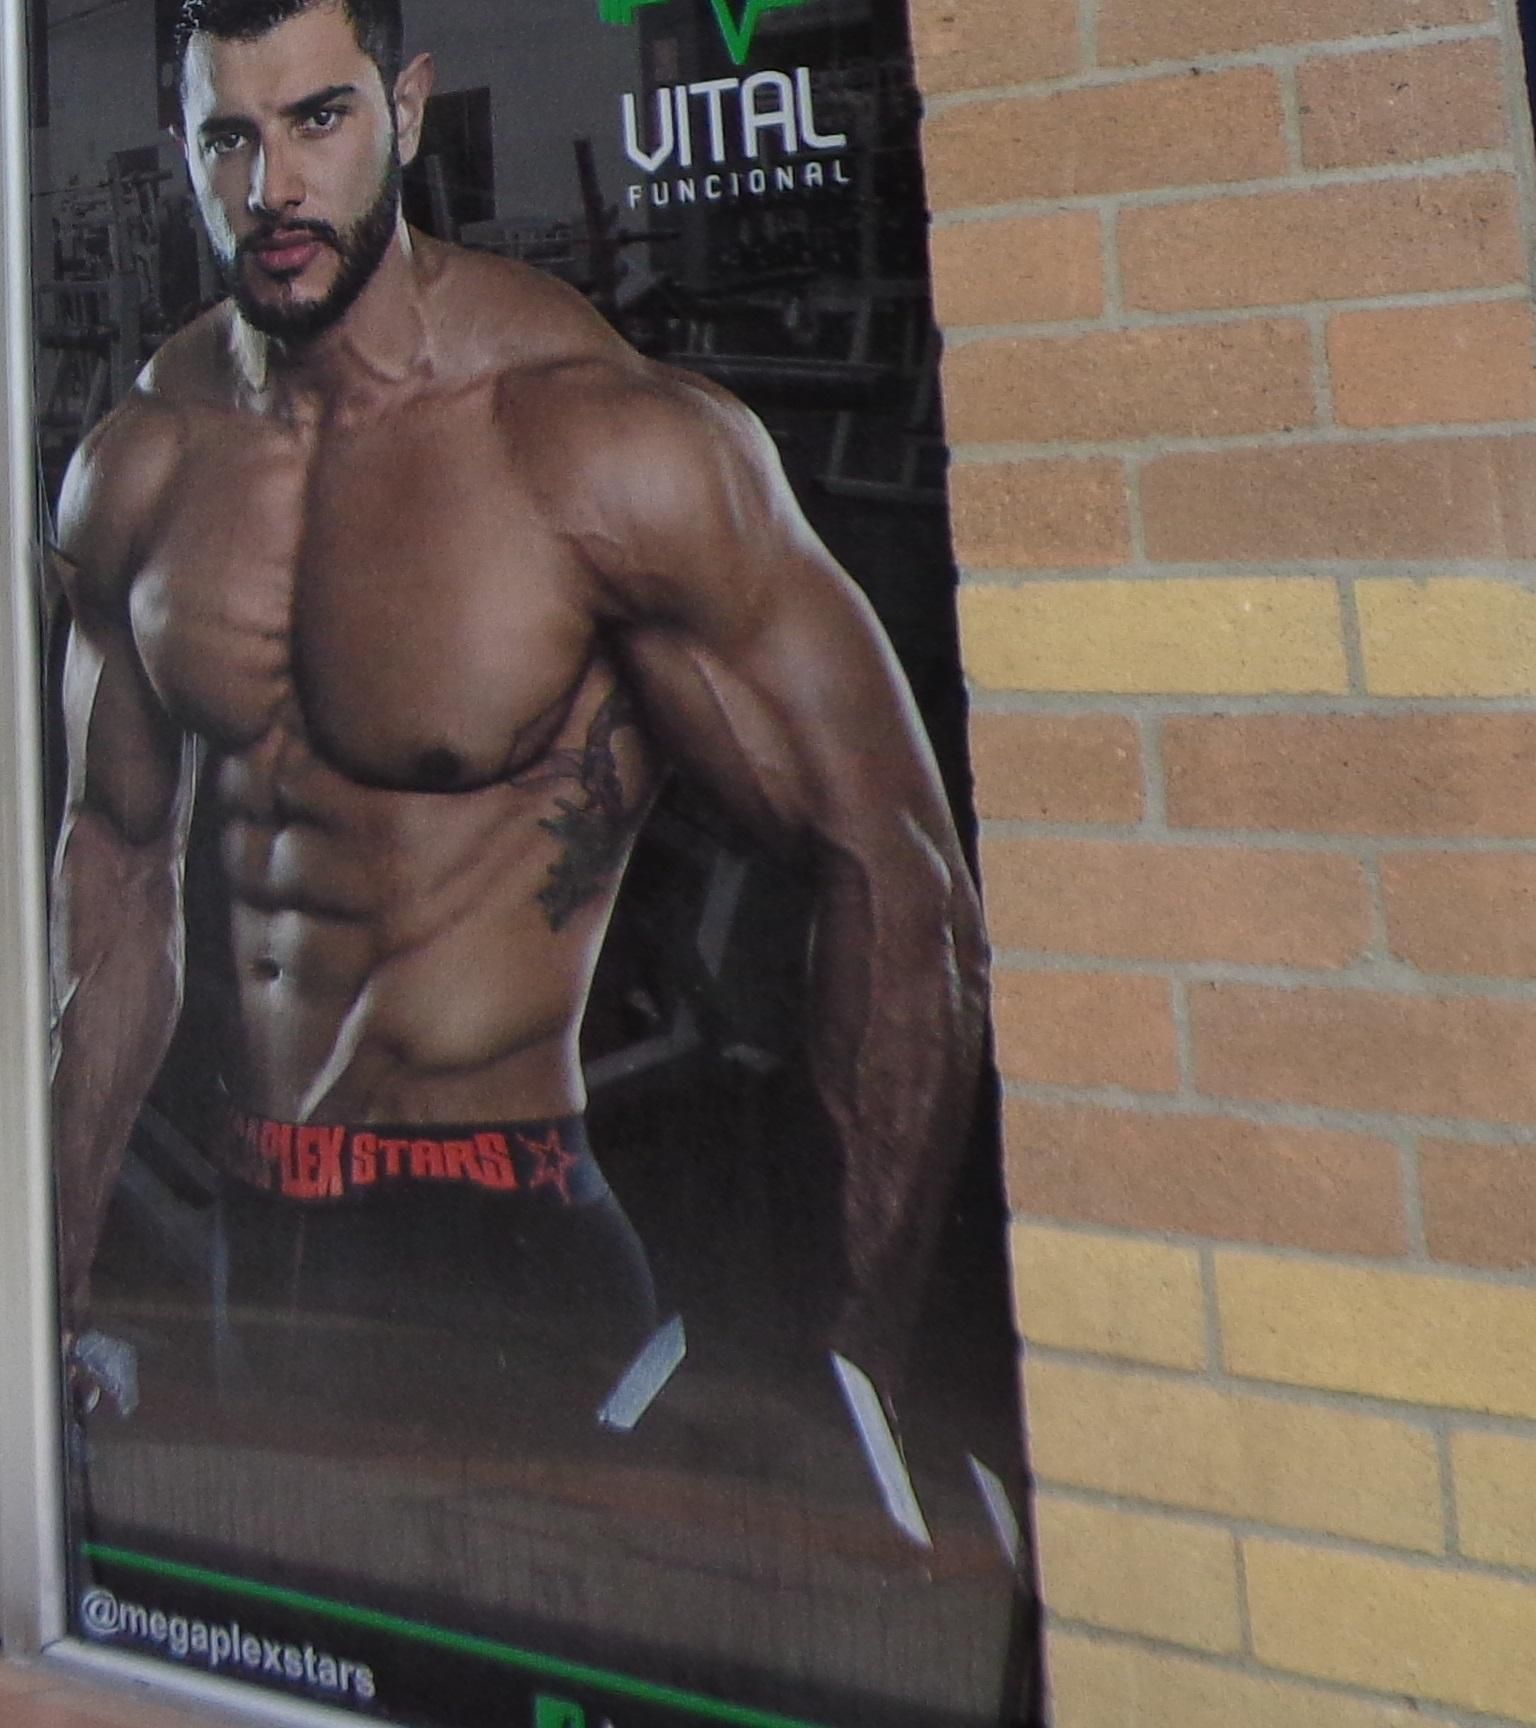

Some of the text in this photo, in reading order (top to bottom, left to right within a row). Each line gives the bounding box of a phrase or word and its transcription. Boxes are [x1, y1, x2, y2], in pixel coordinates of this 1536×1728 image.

[622, 66, 848, 172] VITAL
[628, 159, 851, 210] FUNCIONAL
[351, 1131, 519, 1191] STARS
[81, 1588, 377, 1700] @megaplexstars
